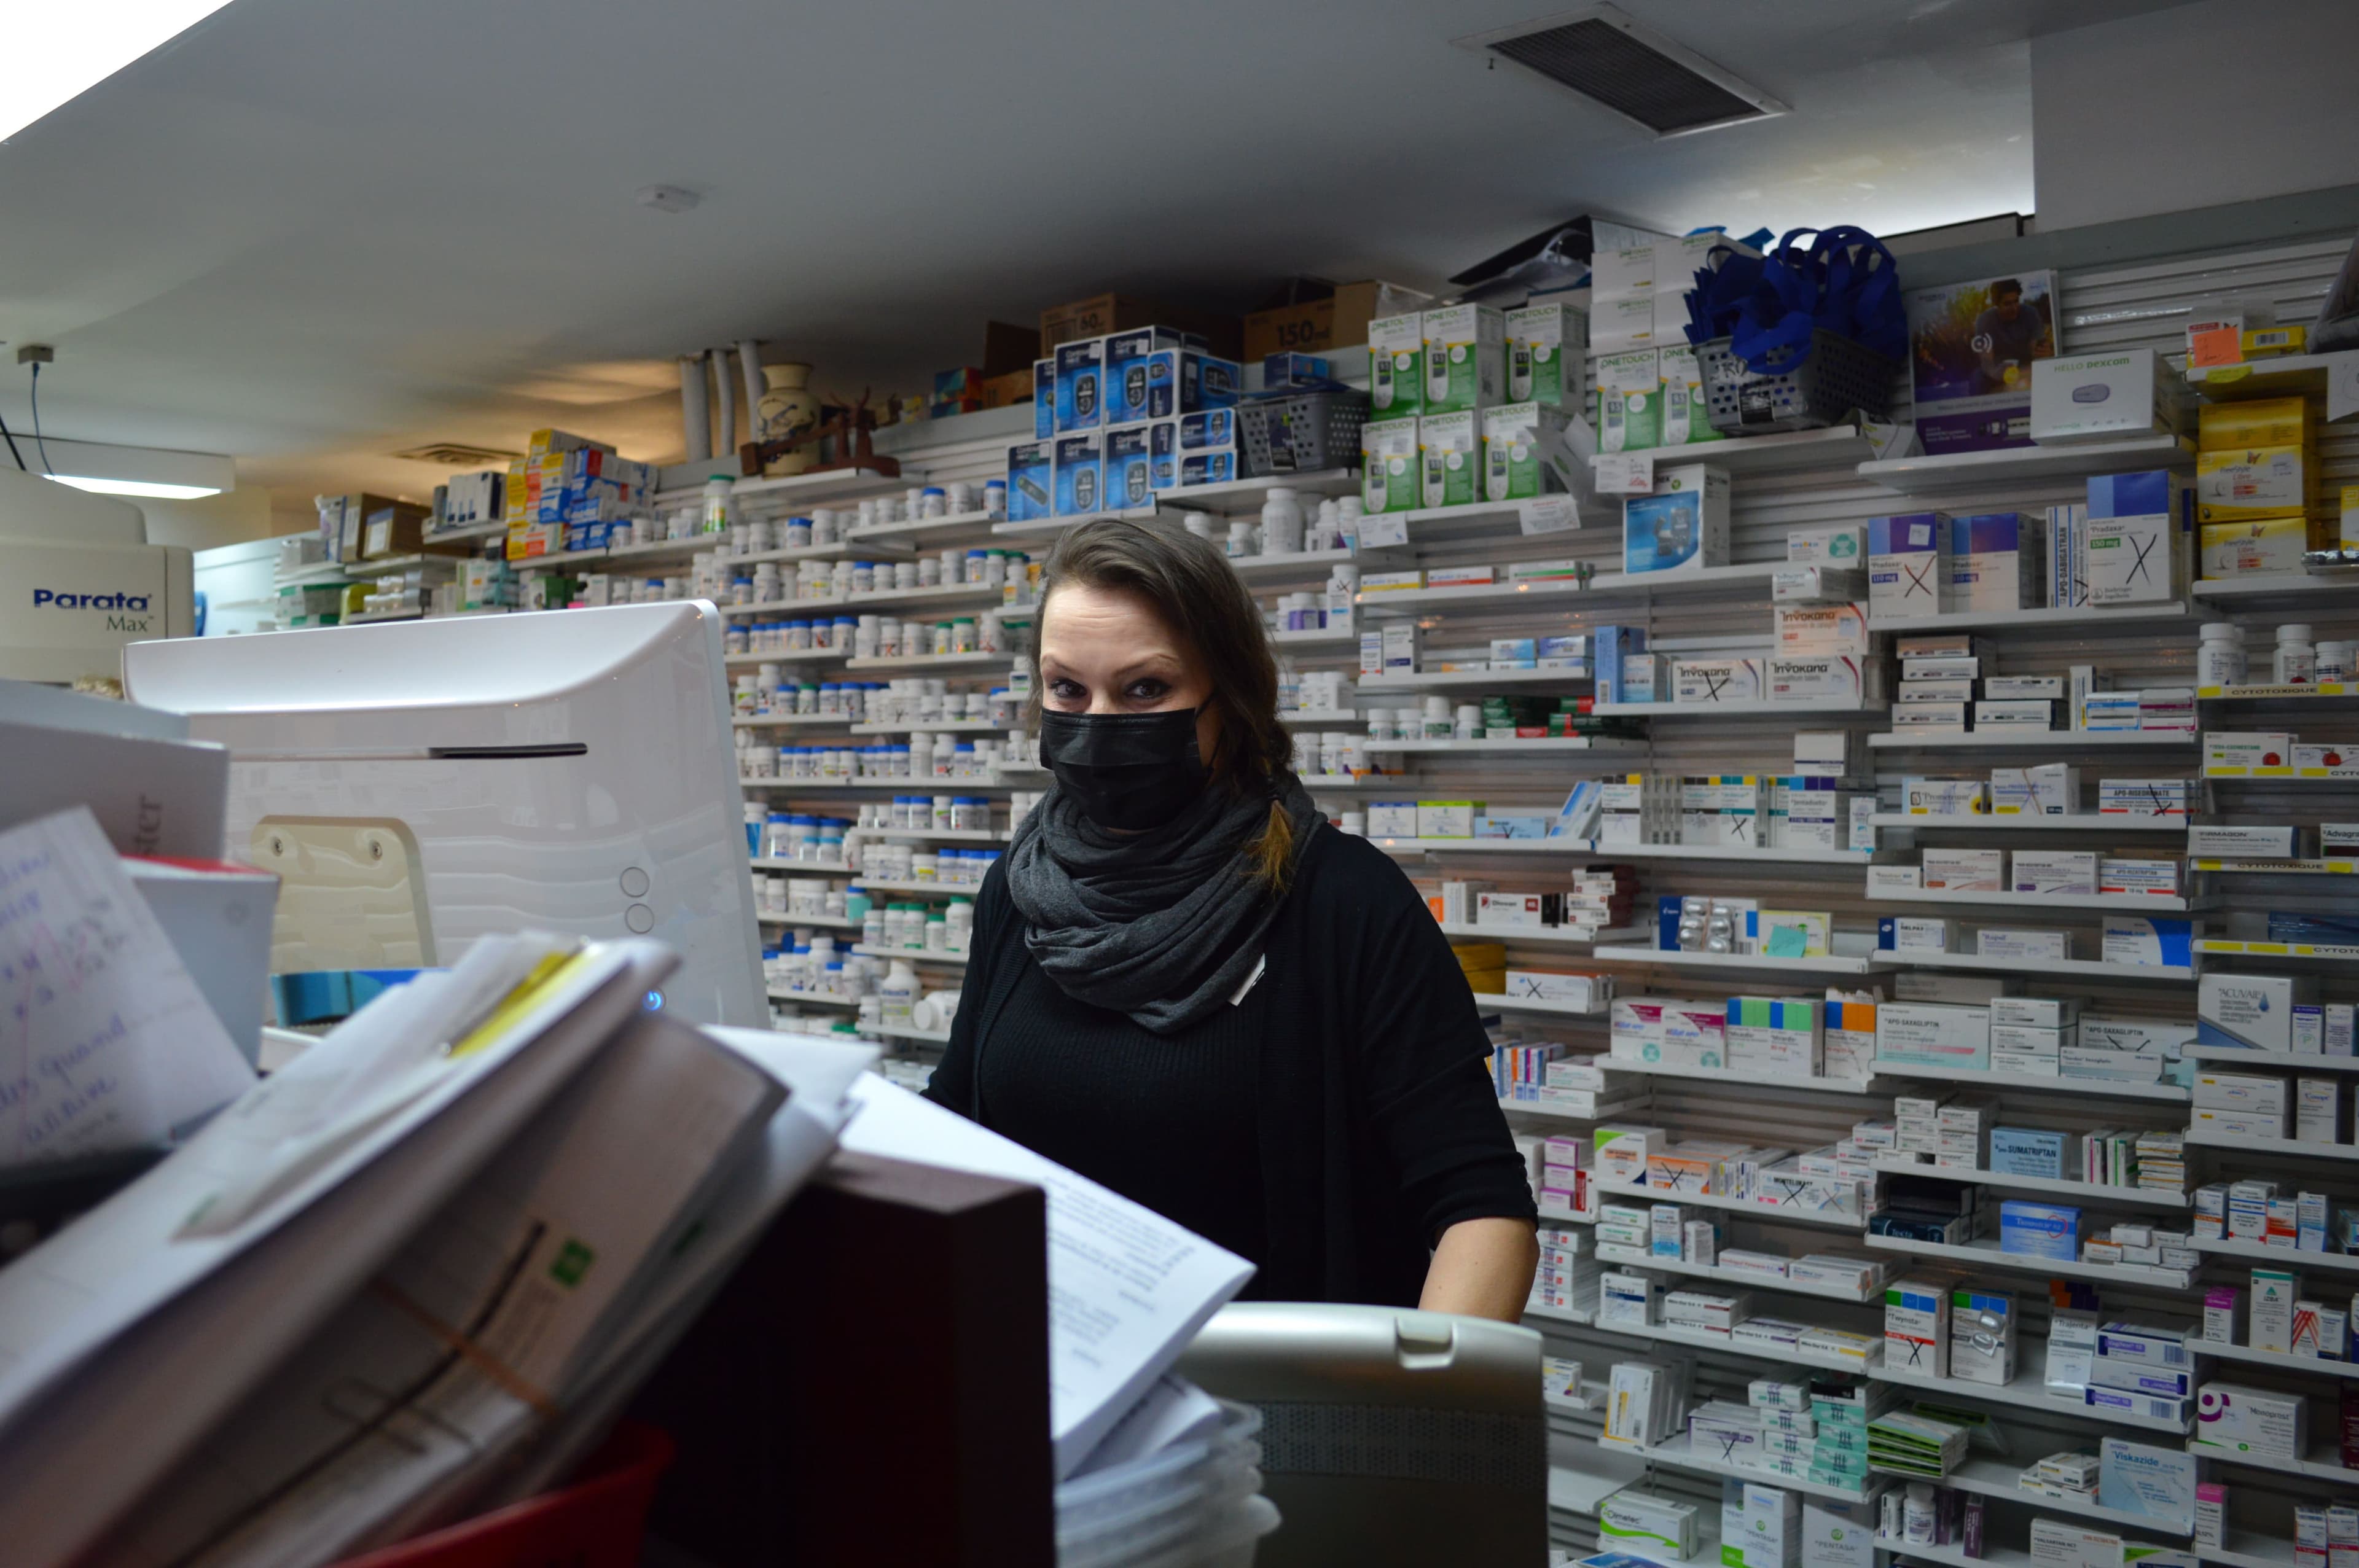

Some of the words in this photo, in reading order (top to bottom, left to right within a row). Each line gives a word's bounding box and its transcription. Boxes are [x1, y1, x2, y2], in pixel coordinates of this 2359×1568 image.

[1425, 310, 1459, 324] ONETO
[1371, 319, 1403, 332] ONETO
[1115, 339, 1135, 348] Contou
[1066, 348, 1090, 358] Contou
[1662, 348, 1691, 362] ONET
[1600, 353, 1654, 369] ONETOUCH
[2054, 363, 2083, 373] HELLO
[1116, 434, 1141, 443] Contou
[2107, 539, 2120, 548] mg
[33, 588, 149, 612] Parata
[1783, 611, 1836, 622] Invokana
[106, 616, 148, 632] Max
[1680, 666, 1731, 677] Invokana
[1774, 662, 1828, 674] Invokana
[2326, 829, 2359, 839] Advagra
[1888, 1018, 1939, 1028] APO-SAXAGLIPTIN
[2089, 1026, 2143, 1036] APO-SAXAGLIPTIN
[2008, 1145, 2056, 1158] SUMATRIPTAN
[1892, 1314, 1919, 1325] Twynsta
[2059, 1319, 2089, 1330] Trajenta
[2250, 1406, 2290, 1421] Monoprost
[2114, 1451, 2159, 1467] Viskazide
[1727, 1510, 1744, 1519] PENT
[1747, 1530, 1775, 1542] PENTASA
[1818, 1541, 1855, 1551] PENTASA
